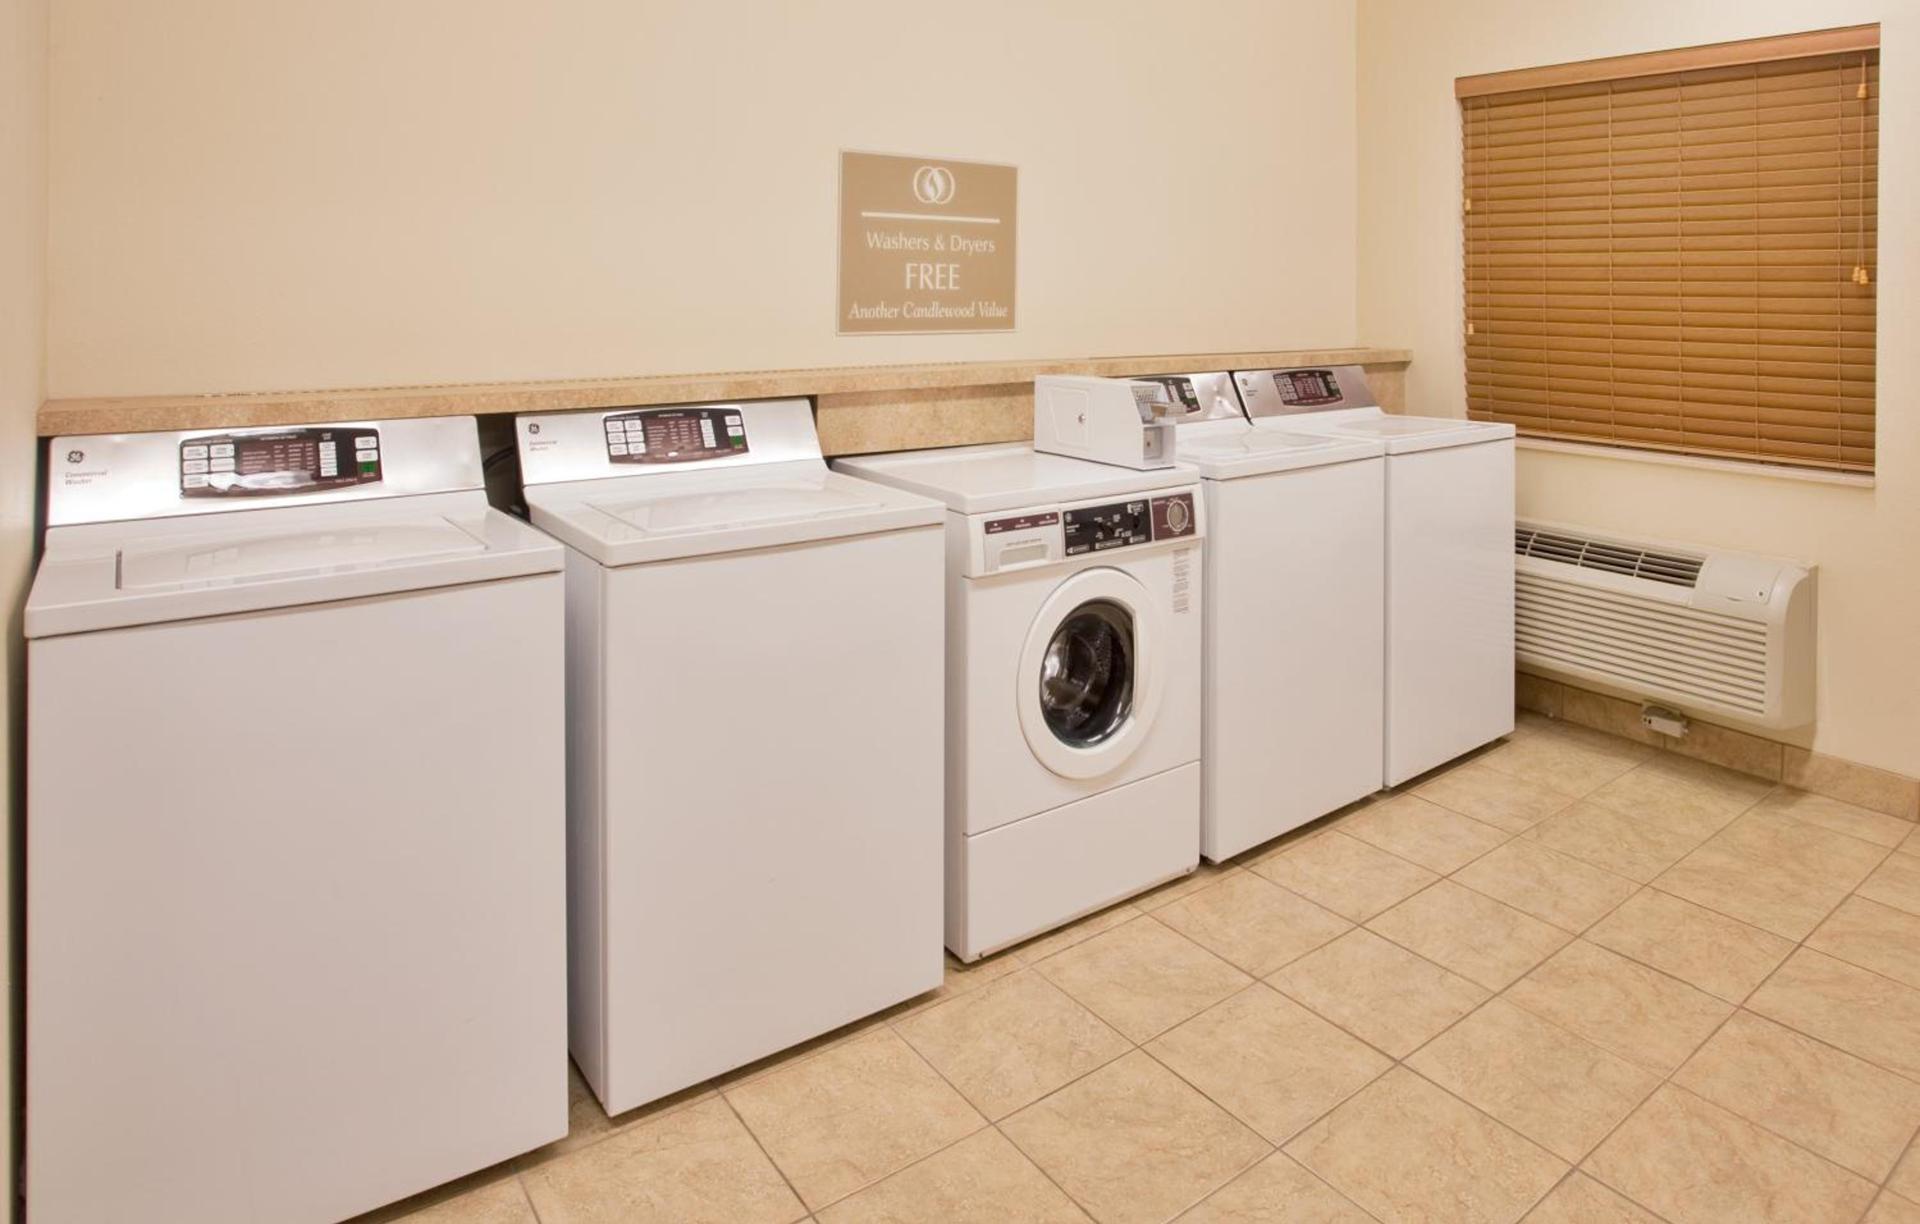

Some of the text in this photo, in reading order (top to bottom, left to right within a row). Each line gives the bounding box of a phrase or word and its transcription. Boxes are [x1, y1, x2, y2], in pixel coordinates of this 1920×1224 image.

[865, 231, 996, 256] Washers & Dryers
[905, 263, 961, 290] FREE
[848, 301, 1009, 319] Another Candlewood Value
